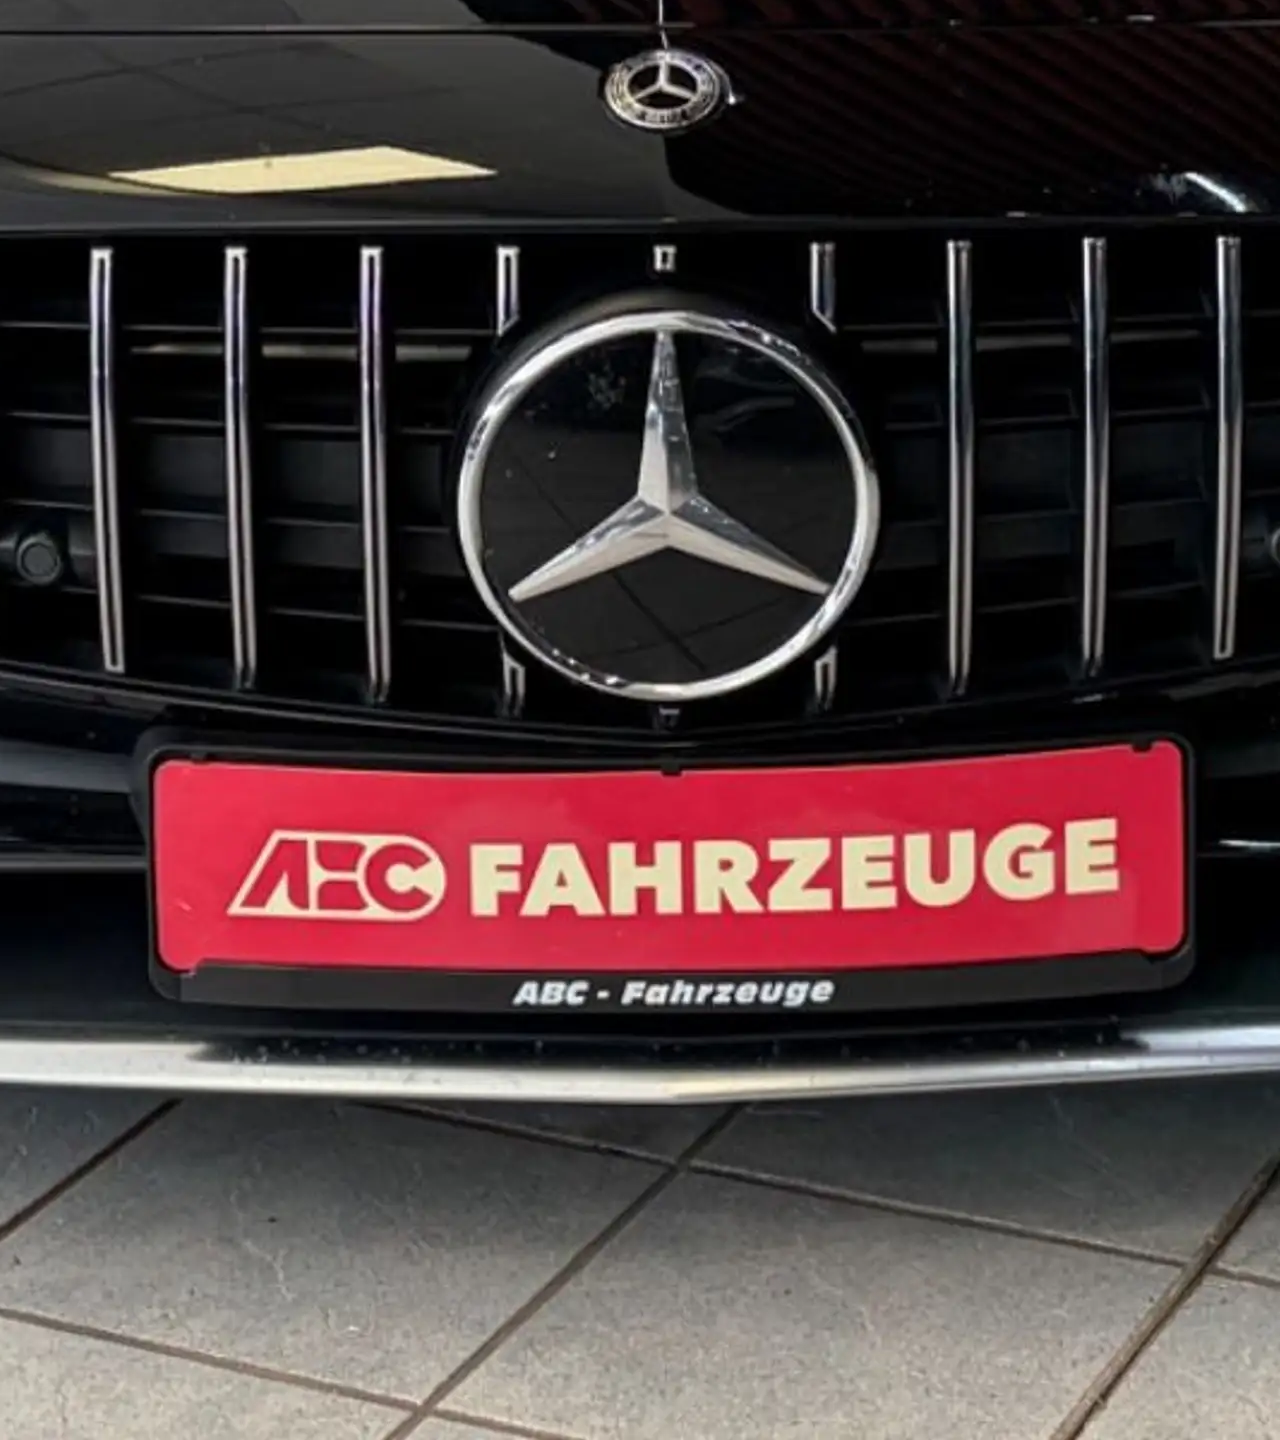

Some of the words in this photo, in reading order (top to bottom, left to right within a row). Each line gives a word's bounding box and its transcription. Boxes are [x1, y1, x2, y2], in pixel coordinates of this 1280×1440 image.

[470, 818, 1119, 917] FAHRZEUGE
[513, 980, 590, 1006] ABC
[620, 979, 836, 1008] Fahrzeuge
